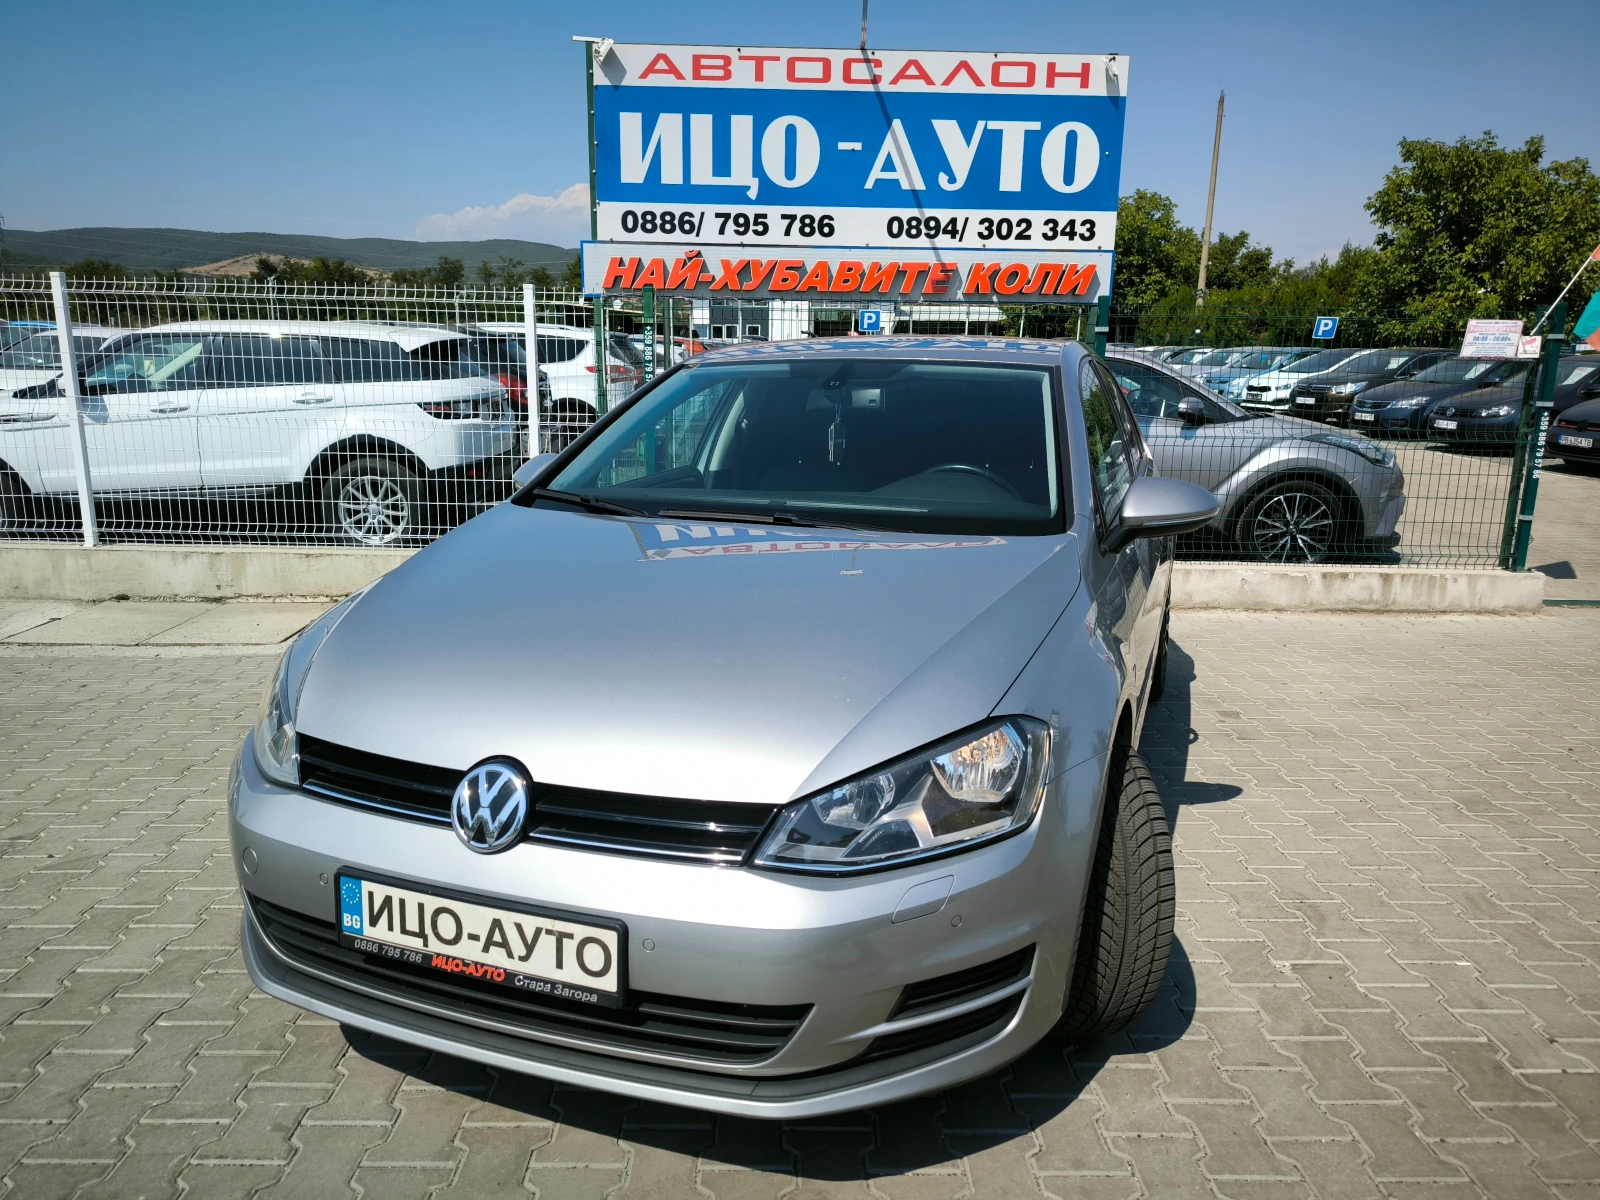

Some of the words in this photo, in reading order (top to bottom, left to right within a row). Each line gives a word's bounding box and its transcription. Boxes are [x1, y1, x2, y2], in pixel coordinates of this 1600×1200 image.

[639, 53, 1091, 90] АВТОСАЛОН
[621, 209, 705, 238] 0886/
[714, 212, 770, 237] 795
[780, 213, 835, 238] 786
[886, 216, 969, 243] 0894/
[977, 217, 1033, 241] 302
[1041, 218, 1096, 242] 343
[602, 249, 957, 294] НАЙ-ХУБАВИТЕ
[963, 262, 1098, 296] КОЛИ
[645, 362, 652, 372] 79
[1540, 411, 1550, 430] +359
[1537, 432, 1547, 446] 886
[1534, 459, 1543, 468] 57
[1535, 447, 1545, 457] 79
[1532, 470, 1541, 479] 86
[343, 912, 361, 930] BG
[367, 890, 614, 978] ИЦО-АУТО
[354, 939, 379, 953] 0886
[381, 945, 401, 958] 795
[403, 950, 423, 963] 786
[431, 953, 506, 984] ИЦО-АУТО
[513, 975, 551, 993] Стара
[553, 983, 599, 1003] Загора
